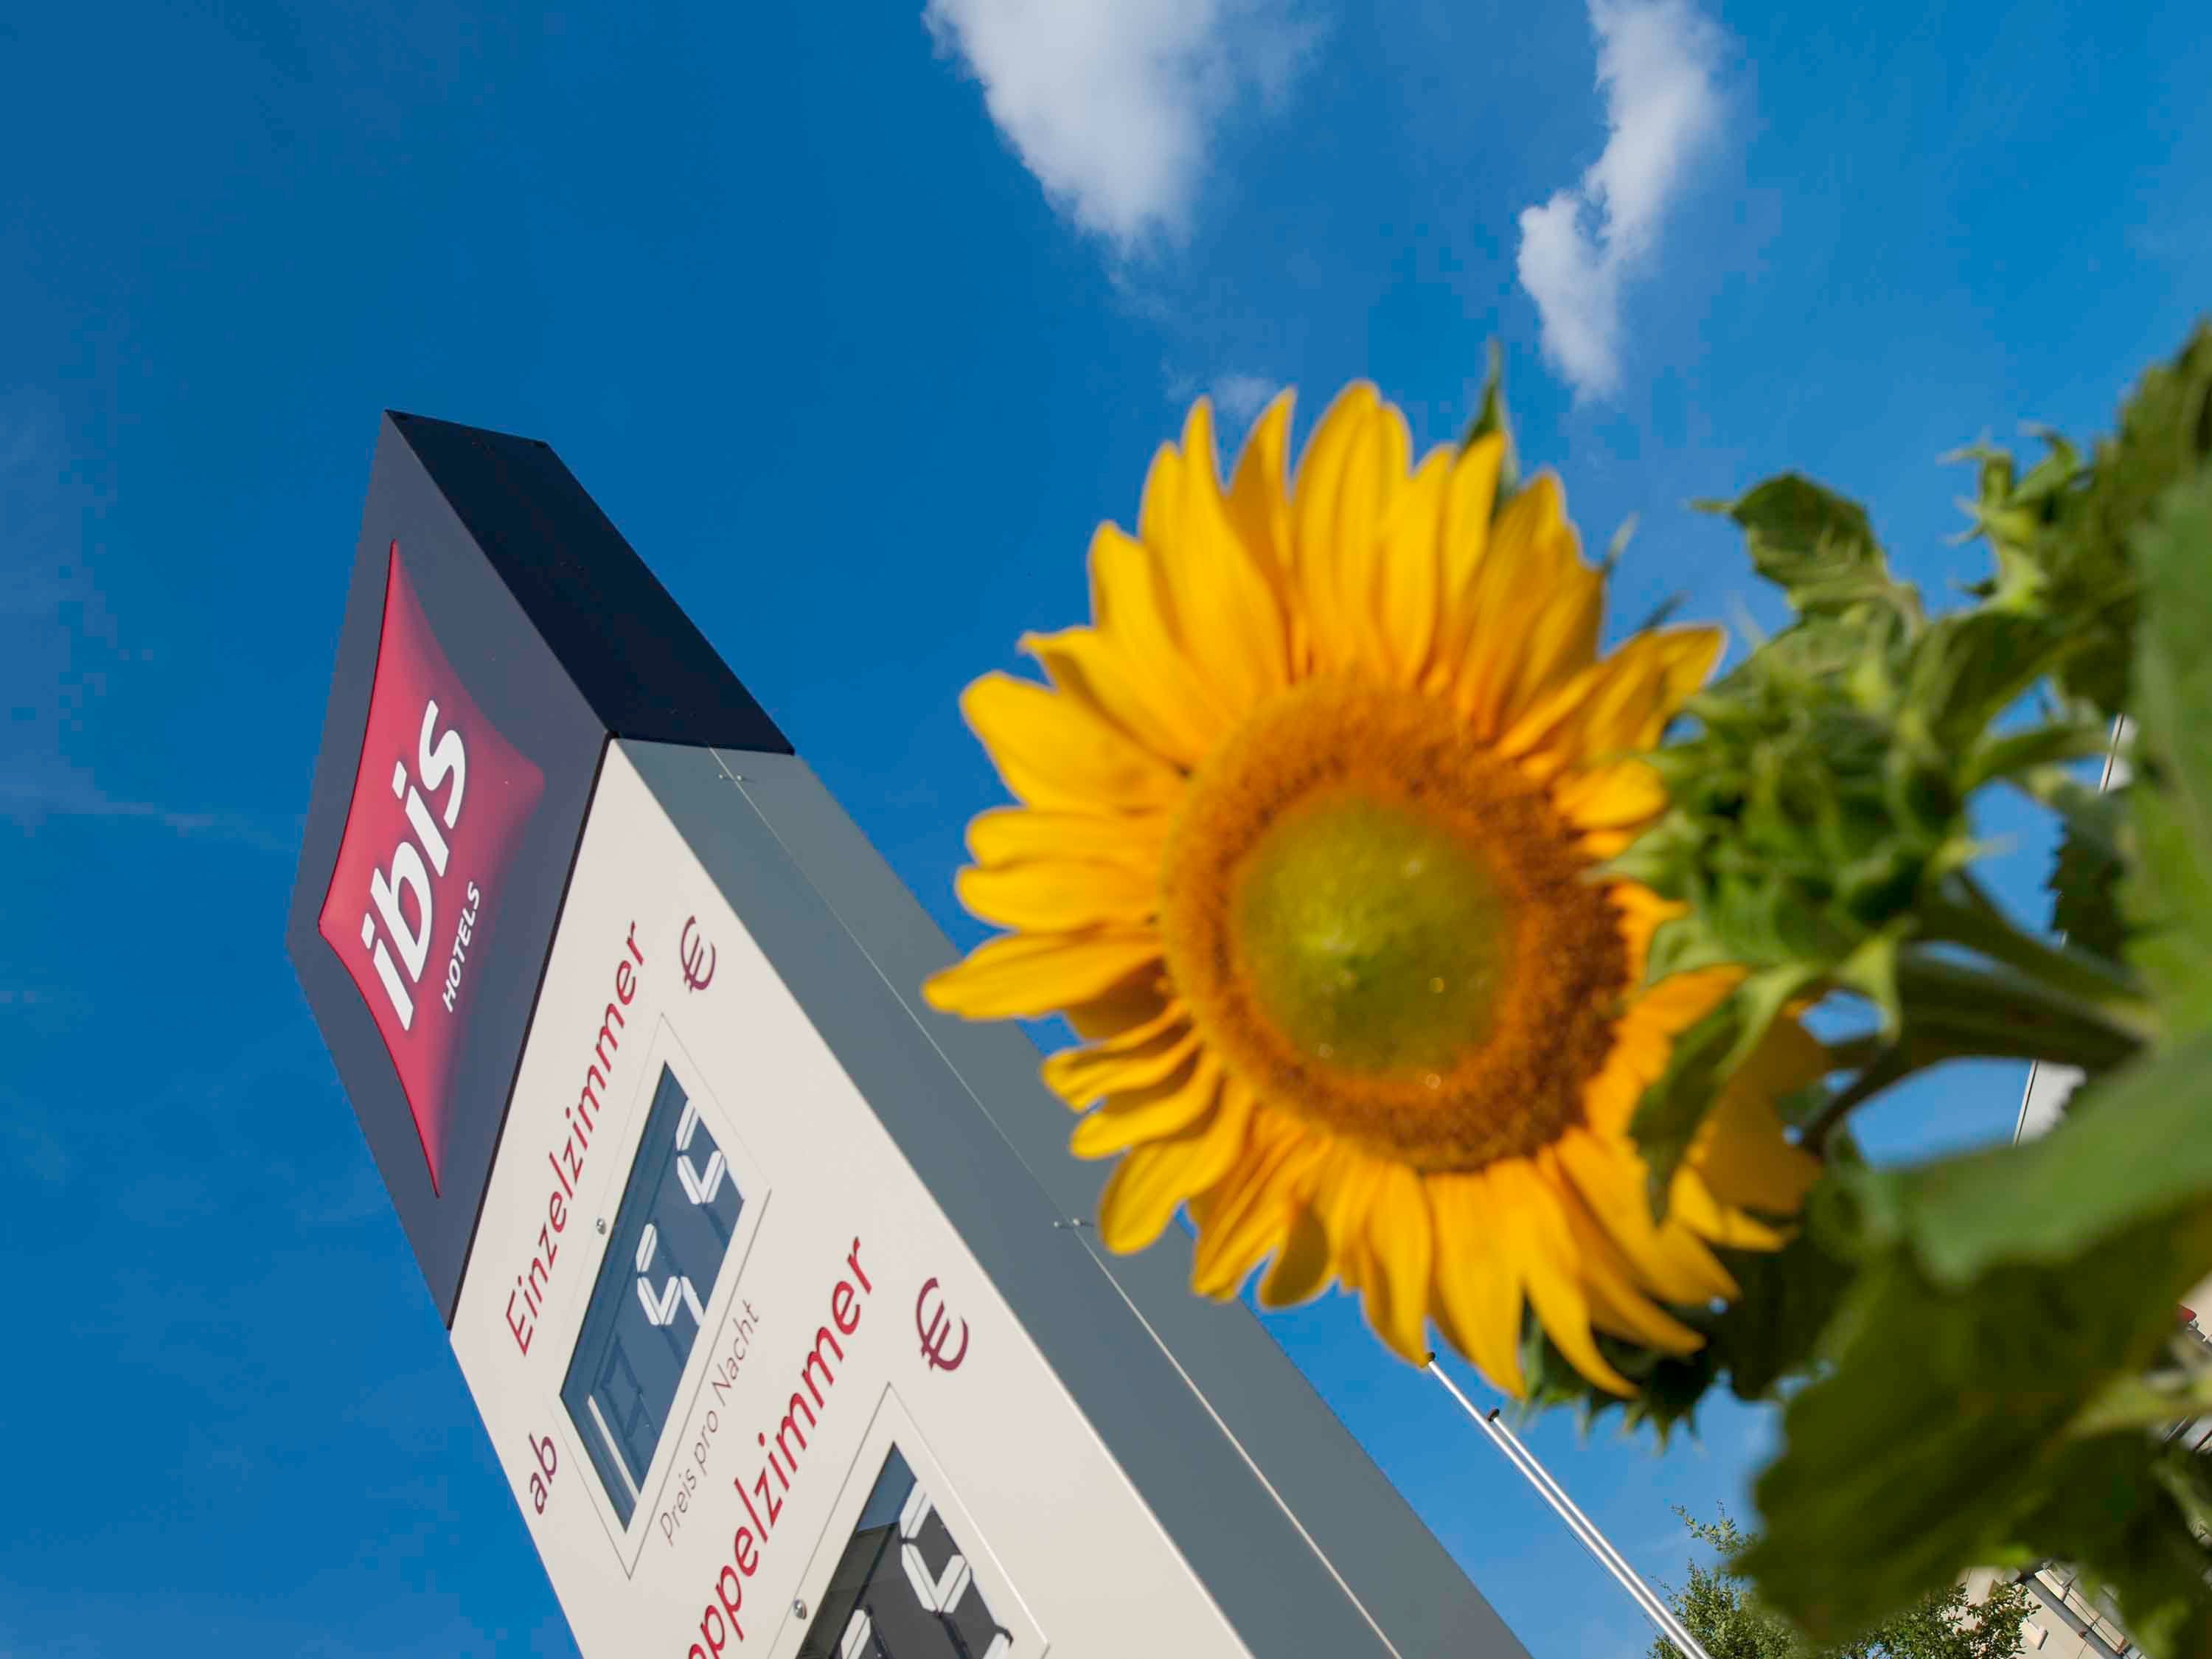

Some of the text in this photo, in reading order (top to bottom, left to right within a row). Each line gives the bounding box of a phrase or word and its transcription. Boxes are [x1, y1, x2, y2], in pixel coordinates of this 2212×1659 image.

[361, 700, 466, 1031] ibis
[442, 881, 481, 1012] HOTELS
[505, 920, 646, 1356] Einzelzimmer
[528, 1433, 558, 1516] ab
[680, 915, 717, 992] €
[659, 1298, 759, 1547] Preis pro Nacht
[915, 1276, 970, 1372] €
